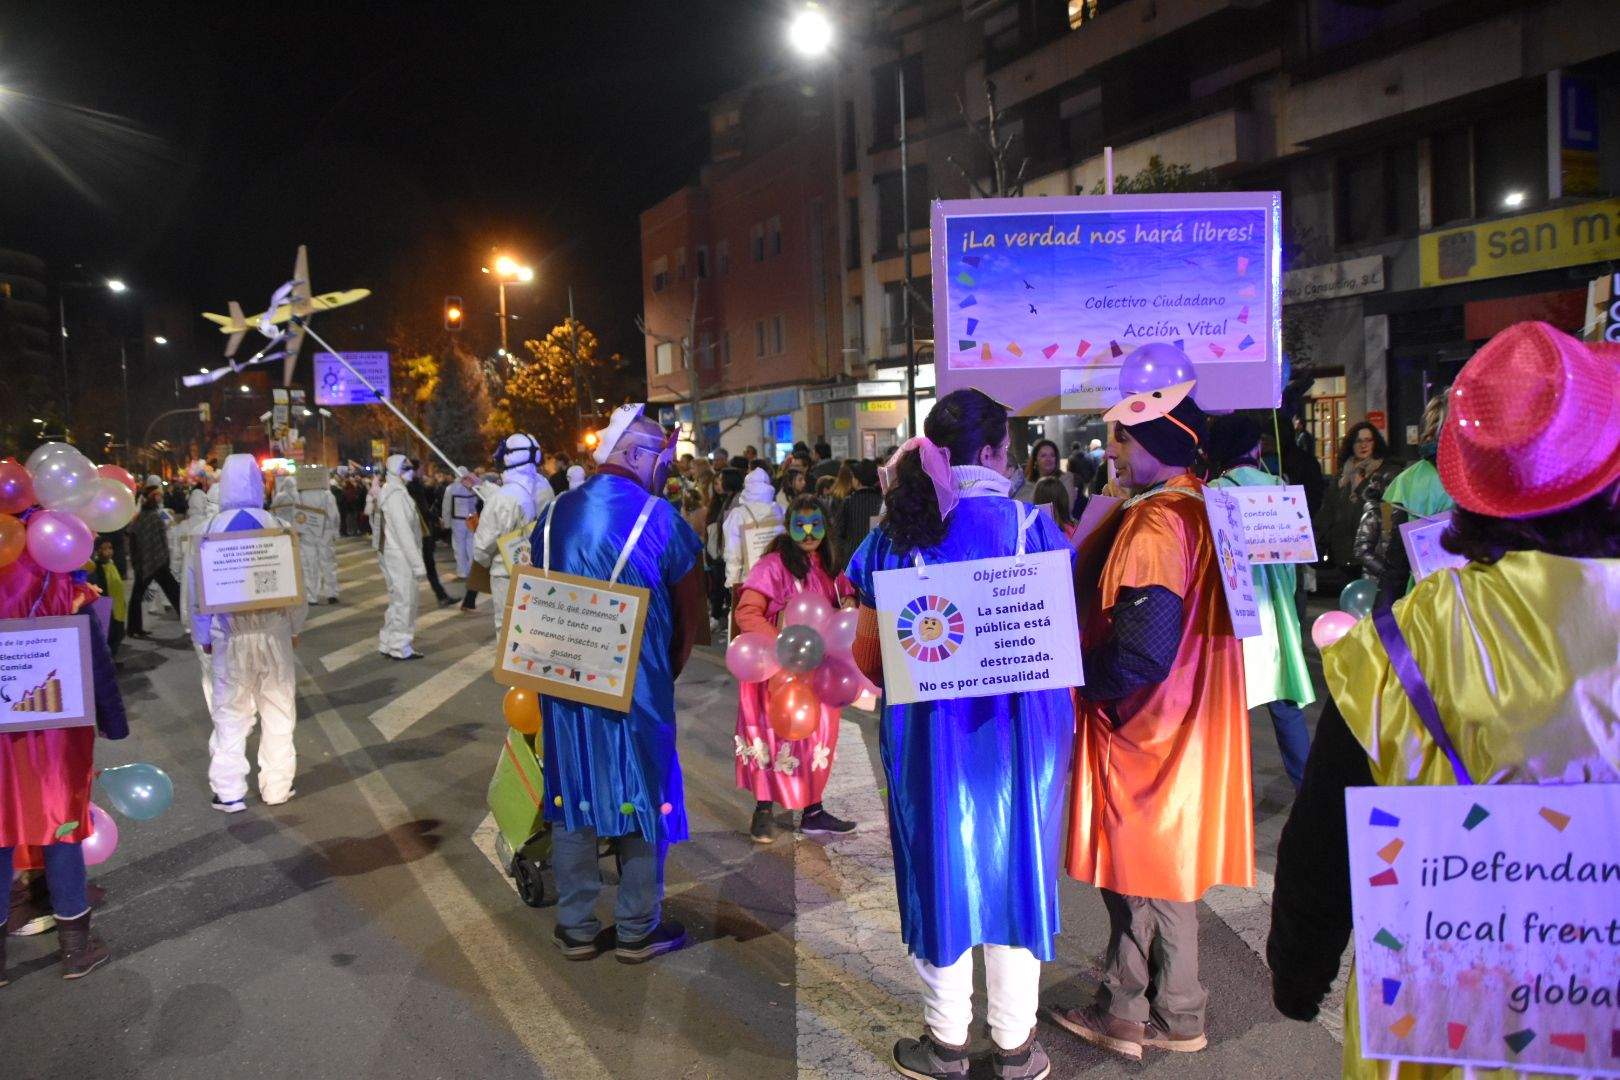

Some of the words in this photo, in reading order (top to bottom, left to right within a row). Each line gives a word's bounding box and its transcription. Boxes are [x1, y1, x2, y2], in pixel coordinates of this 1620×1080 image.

[1567, 87, 1592, 141] L
[963, 230, 995, 253] ¡La
[1004, 224, 1080, 247] verdad
[1090, 229, 1126, 244] nos
[1134, 222, 1183, 243] hará
[1192, 221, 1254, 242] libres!
[1489, 221, 1557, 259] san
[1573, 211, 1620, 246] m
[1085, 295, 1147, 309] Colectivo
[1152, 294, 1226, 308] Ciudadano
[1123, 320, 1181, 338] Acción
[1187, 319, 1228, 336] Vital
[870, 402, 893, 410] ONCE
[1243, 509, 1278, 518] controla
[973, 566, 1038, 583] Objetivos:
[992, 584, 1026, 598] Salud
[557, 602, 565, 611] lo
[566, 604, 580, 613] que
[977, 606, 992, 617] La
[995, 599, 1045, 615] sanidad
[541, 614, 555, 623] Por
[557, 616, 565, 625] lo
[566, 620, 589, 631] tanto
[591, 625, 602, 633] no
[975, 617, 1021, 636] pública
[1024, 616, 1051, 630] está
[25, 638, 57, 647] pobreza
[529, 628, 565, 642] comemos
[567, 635, 598, 649] insectos
[994, 635, 1036, 649] siendo
[0, 651, 50, 661] Electricidad
[550, 649, 582, 661] gusanos
[980, 652, 1054, 668] destrozada.
[919, 681, 937, 692] No
[940, 680, 954, 690] es
[957, 677, 979, 693] por
[982, 668, 1050, 685] casualidad
[1425, 911, 1507, 942] local
[1524, 912, 1620, 944] frent
[1508, 974, 1620, 1013] global
